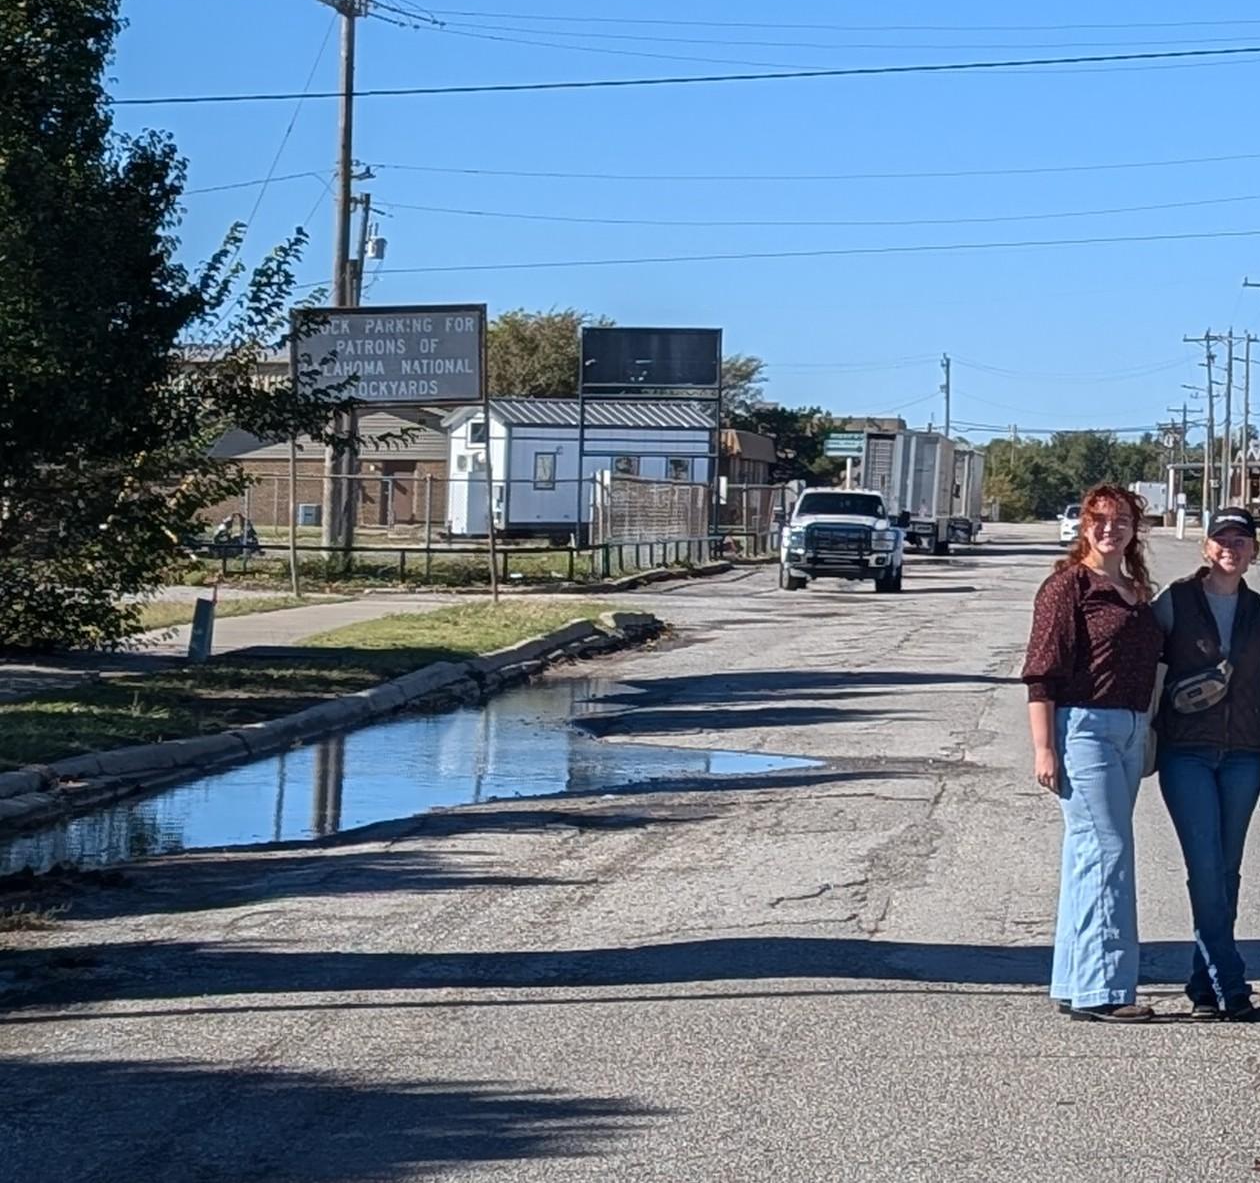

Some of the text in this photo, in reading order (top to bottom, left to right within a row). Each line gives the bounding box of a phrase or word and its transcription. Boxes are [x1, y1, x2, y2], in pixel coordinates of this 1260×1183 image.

[365, 318, 432, 334] PARKING
[445, 317, 475, 332] FOR
[336, 338, 439, 355] PATRONS OF
[401, 358, 473, 374] NATIONAL
[350, 380, 438, 396] OCKYARDS
